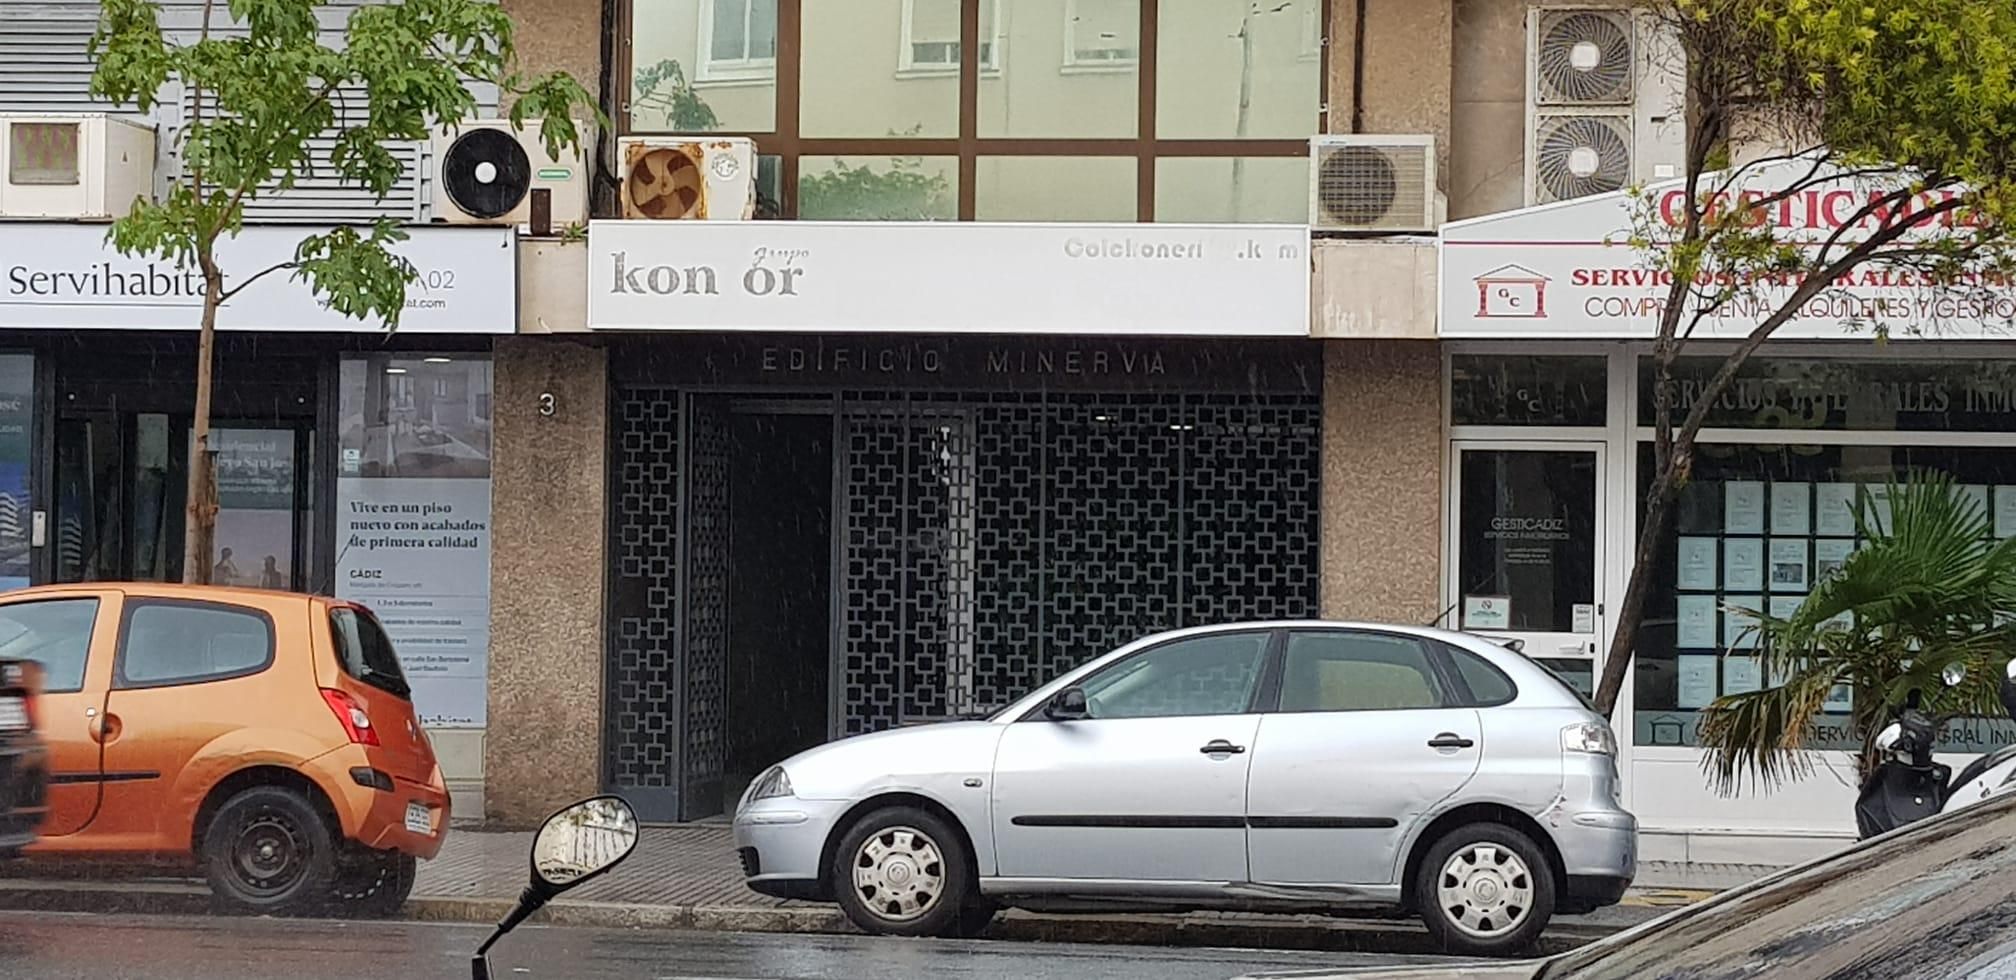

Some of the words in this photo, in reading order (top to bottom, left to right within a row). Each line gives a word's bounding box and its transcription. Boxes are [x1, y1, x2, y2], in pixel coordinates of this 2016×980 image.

[9, 262, 229, 297] Servihabitat
[1571, 269, 1734, 286] SERVICOS
[763, 348, 938, 372] EDIFICIO
[1654, 378, 1777, 410] SERVCIOS
[540, 393, 554, 416] 3
[350, 501, 379, 513] Vive
[382, 505, 399, 513] en
[402, 505, 419, 513] un
[423, 502, 452, 516] piso
[350, 521, 391, 531] nuevo
[394, 521, 419, 531] con
[422, 520, 486, 531] acabados
[1491, 518, 1563, 531] GESTICADIZ
[350, 535, 366, 548] de
[370, 536, 425, 550] primera
[428, 536, 478, 548] calidad
